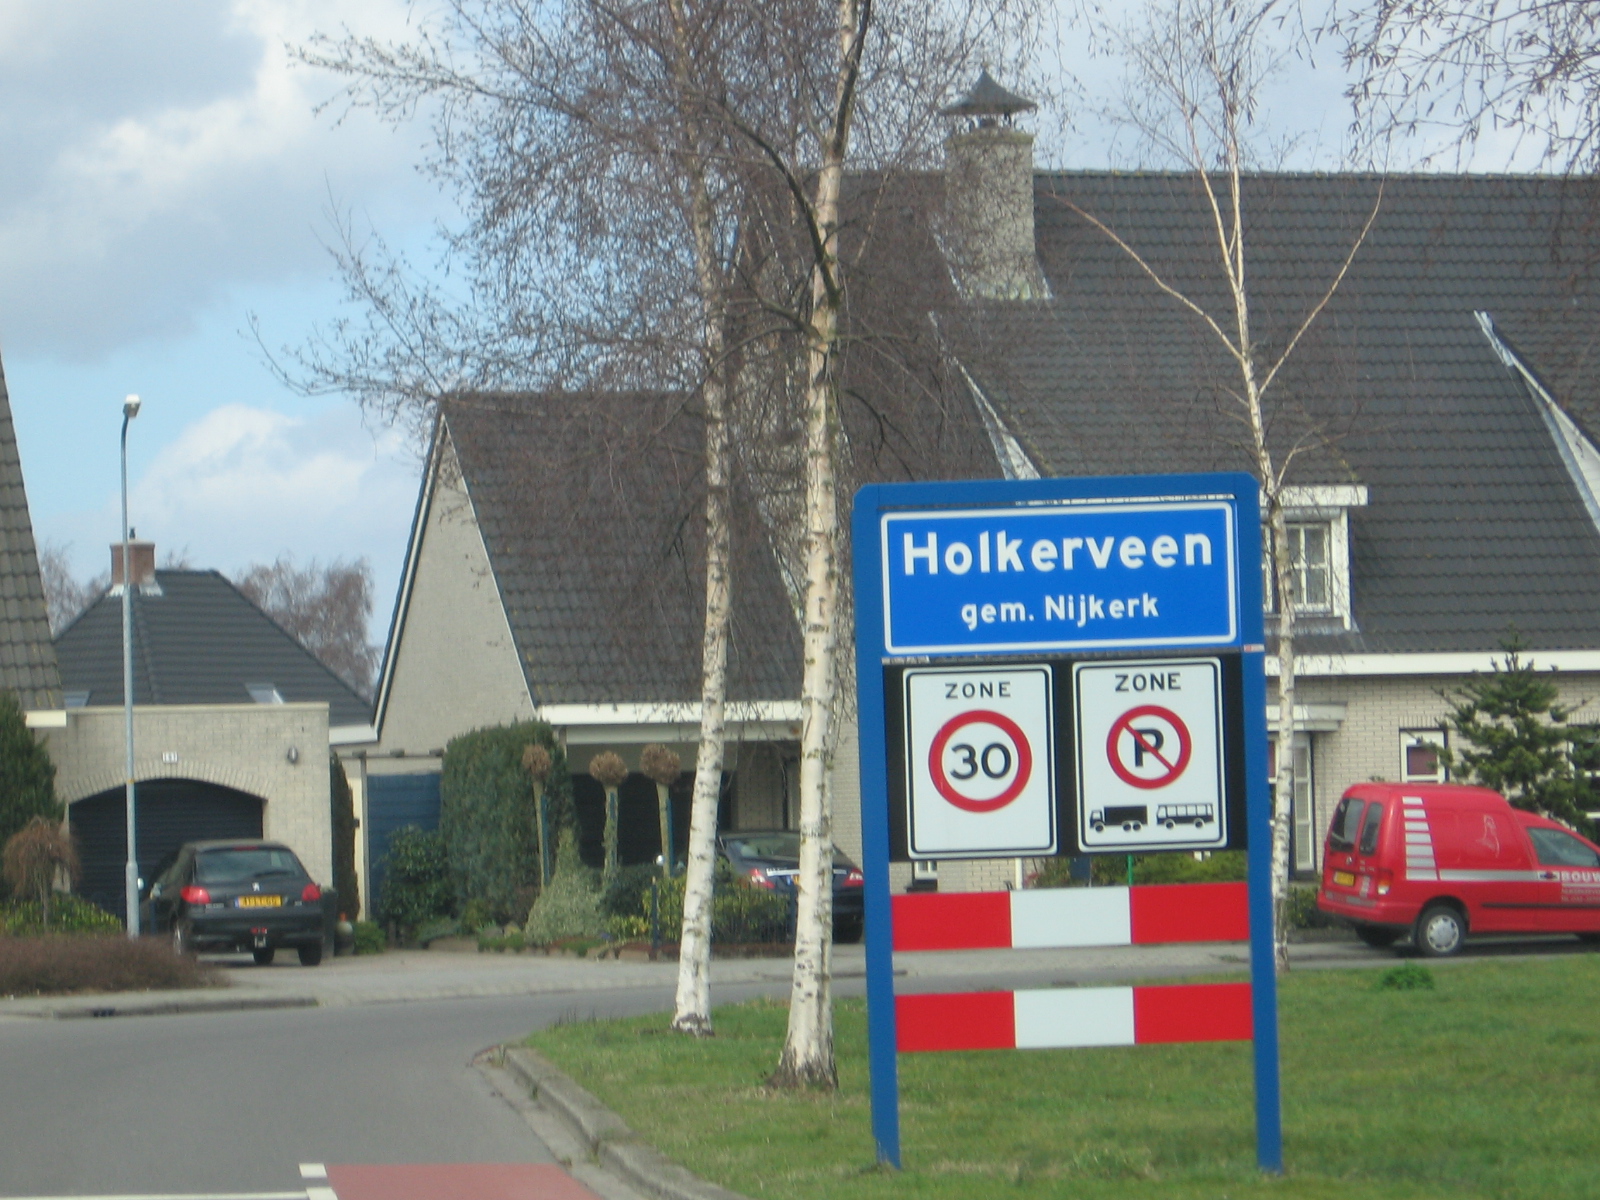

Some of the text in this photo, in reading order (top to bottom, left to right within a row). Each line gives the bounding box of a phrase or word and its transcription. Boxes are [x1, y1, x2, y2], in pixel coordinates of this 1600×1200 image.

[903, 530, 1212, 576] Holkerveen
[961, 592, 1160, 631] gem. Nijkerk
[945, 681, 1012, 699] ZONE
[1115, 672, 1182, 692] ZONE
[949, 742, 1012, 781] 30
